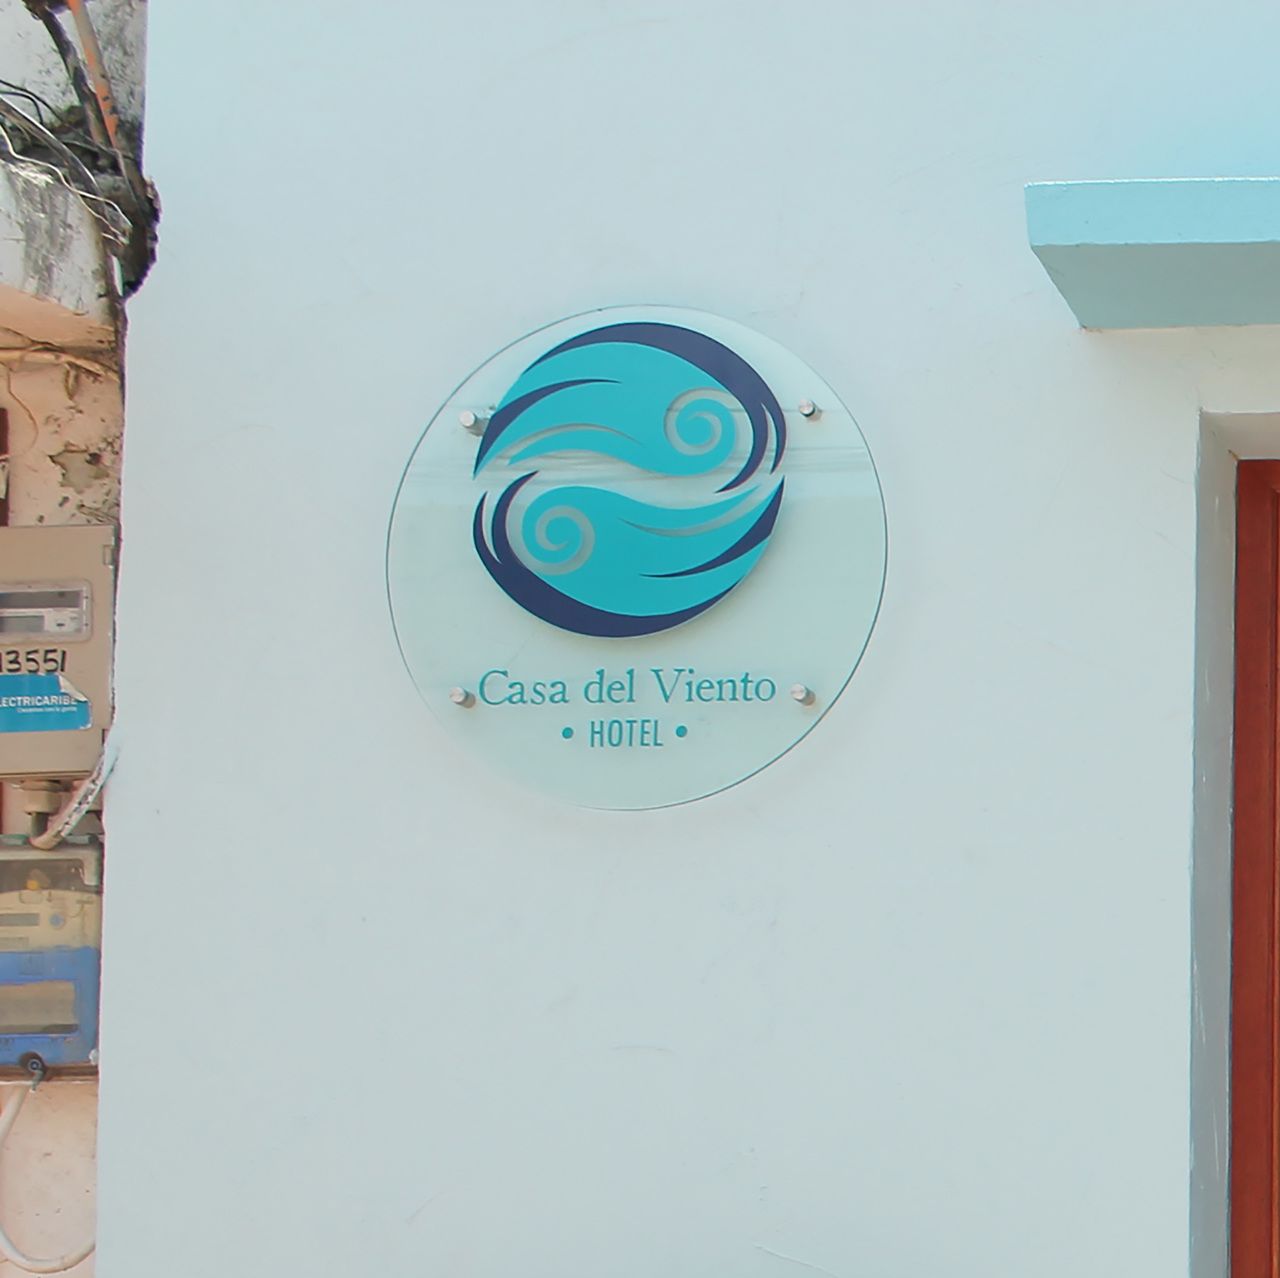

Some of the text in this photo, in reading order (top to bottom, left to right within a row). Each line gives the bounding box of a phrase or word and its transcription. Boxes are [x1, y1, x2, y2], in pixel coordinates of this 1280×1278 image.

[478, 667, 777, 705] Casa del Viento
[589, 719, 664, 748] HOTEL
